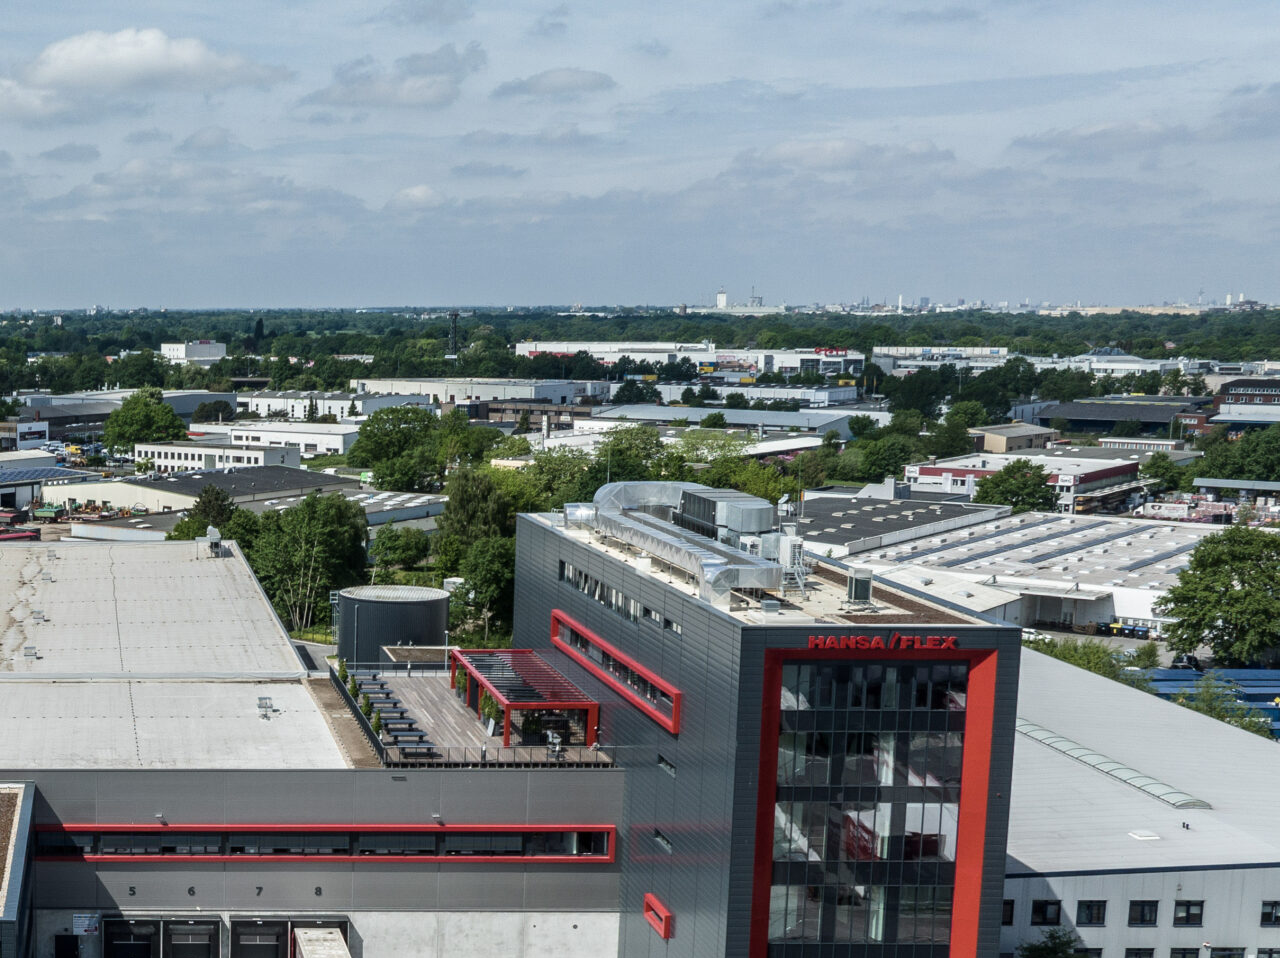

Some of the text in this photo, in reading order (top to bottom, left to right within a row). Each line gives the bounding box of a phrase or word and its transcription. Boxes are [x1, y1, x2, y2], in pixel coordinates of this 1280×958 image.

[808, 635, 958, 650] HANSA FLEX
[128, 886, 136, 897] 5
[187, 886, 196, 896] 6
[256, 886, 263, 896] 7
[314, 886, 322, 896] 8
